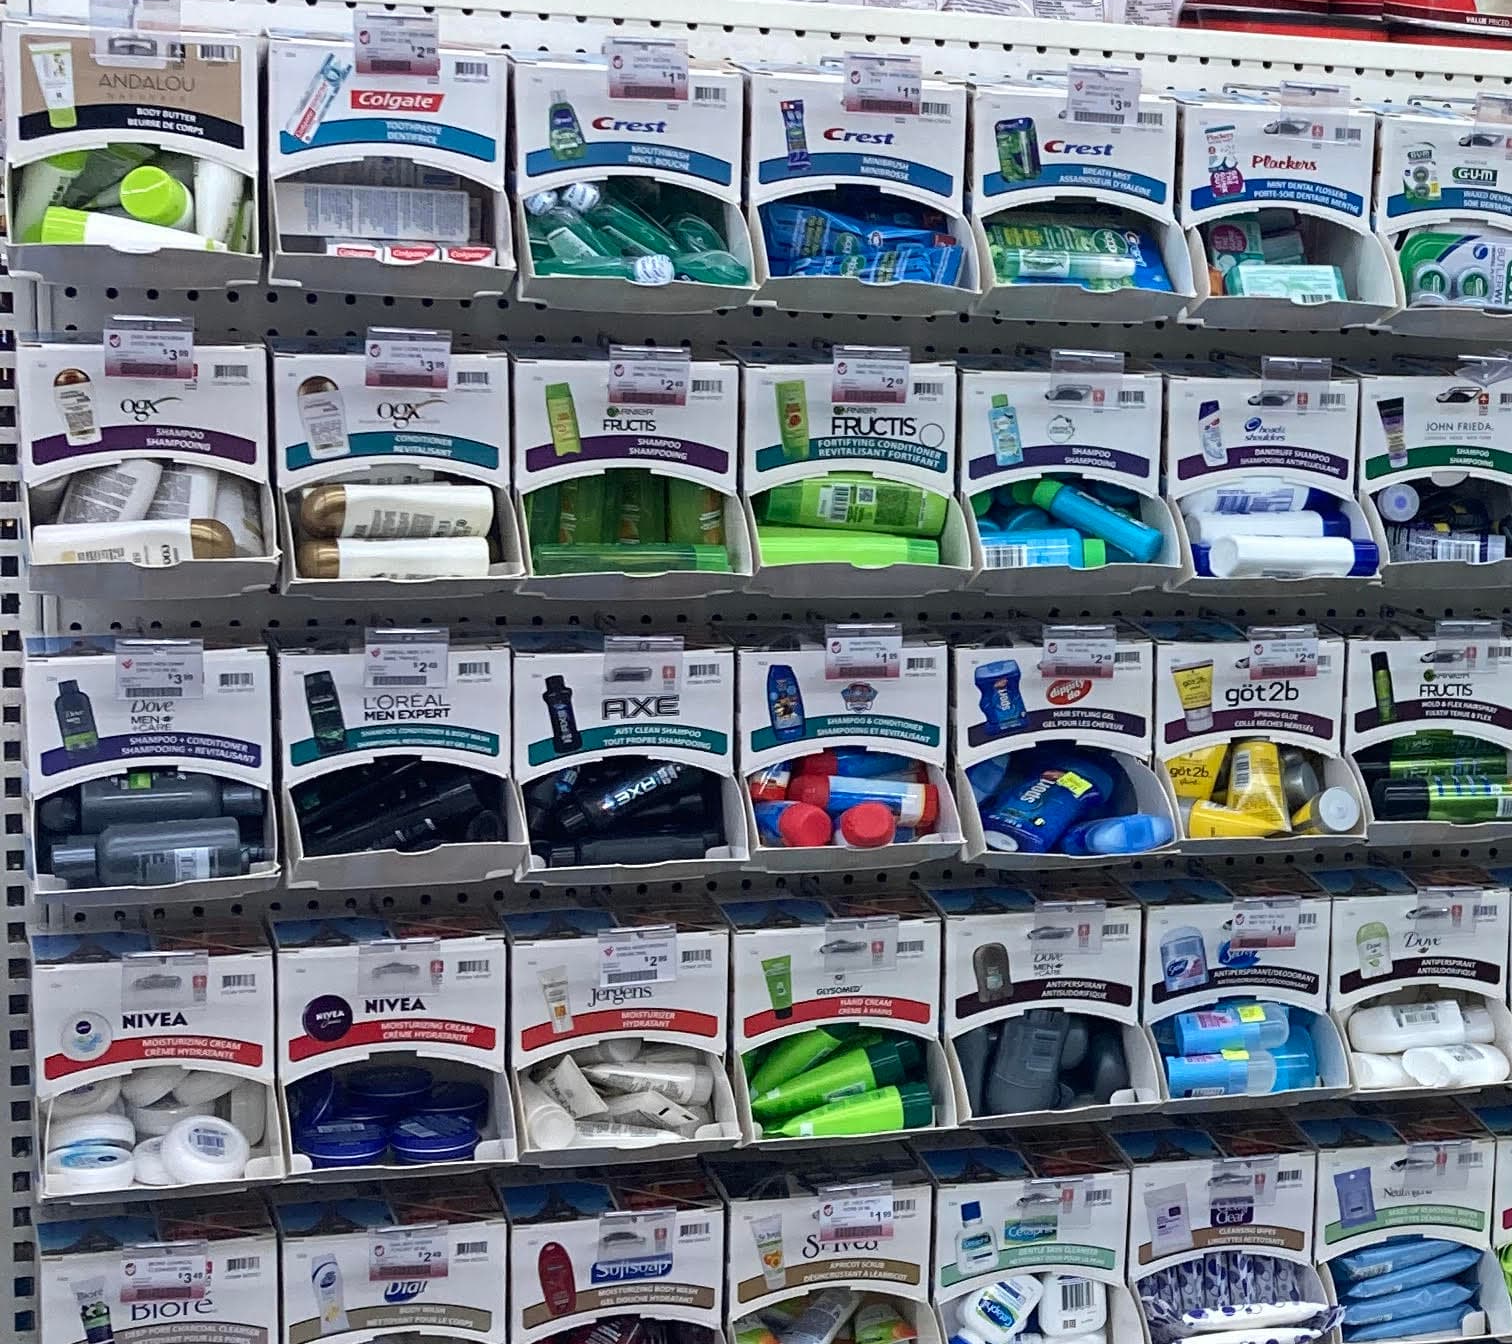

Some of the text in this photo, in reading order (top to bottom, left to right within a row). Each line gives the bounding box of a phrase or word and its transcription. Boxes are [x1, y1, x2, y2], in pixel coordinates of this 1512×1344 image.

[99, 74, 196, 92] ANDALOU
[358, 92, 433, 110] Colgate
[591, 116, 668, 134] Crest
[823, 128, 894, 144] Crest
[1043, 140, 1114, 156] Crest
[1250, 154, 1318, 171] Plackers
[603, 419, 656, 431] FRUCTIS
[832, 416, 917, 436] FRUCTIS
[1425, 422, 1455, 432] JOHN
[156, 428, 205, 440] SHAMPOO
[637, 438, 681, 449] SHAMPOO
[818, 438, 941, 460] FORTIFYING CONDITIONER
[629, 446, 688, 460] SHAMPOOING
[1072, 448, 1111, 458] SHAMPOO
[1225, 681, 1299, 707] göt2b
[1419, 684, 1472, 697] FRUCTIS
[131, 699, 174, 712] Dove
[601, 694, 680, 720] AXE
[131, 716, 159, 725] MEN
[364, 708, 450, 721] MEN EXPERT
[614, 726, 702, 739] JUST CLEAN SHAMPOO
[130, 734, 177, 746] SHAMPOO
[186, 737, 248, 752] CONDITIONER
[1404, 932, 1442, 948] Dove
[587, 984, 653, 1007] Jergens
[365, 998, 426, 1013] NIVEA
[122, 1012, 188, 1028] NIVEA
[380, 1022, 475, 1034] MOISTURIZING CREAM
[142, 1038, 242, 1050] MOISTURIZING CREAM
[1216, 1213, 1244, 1224] Clear
